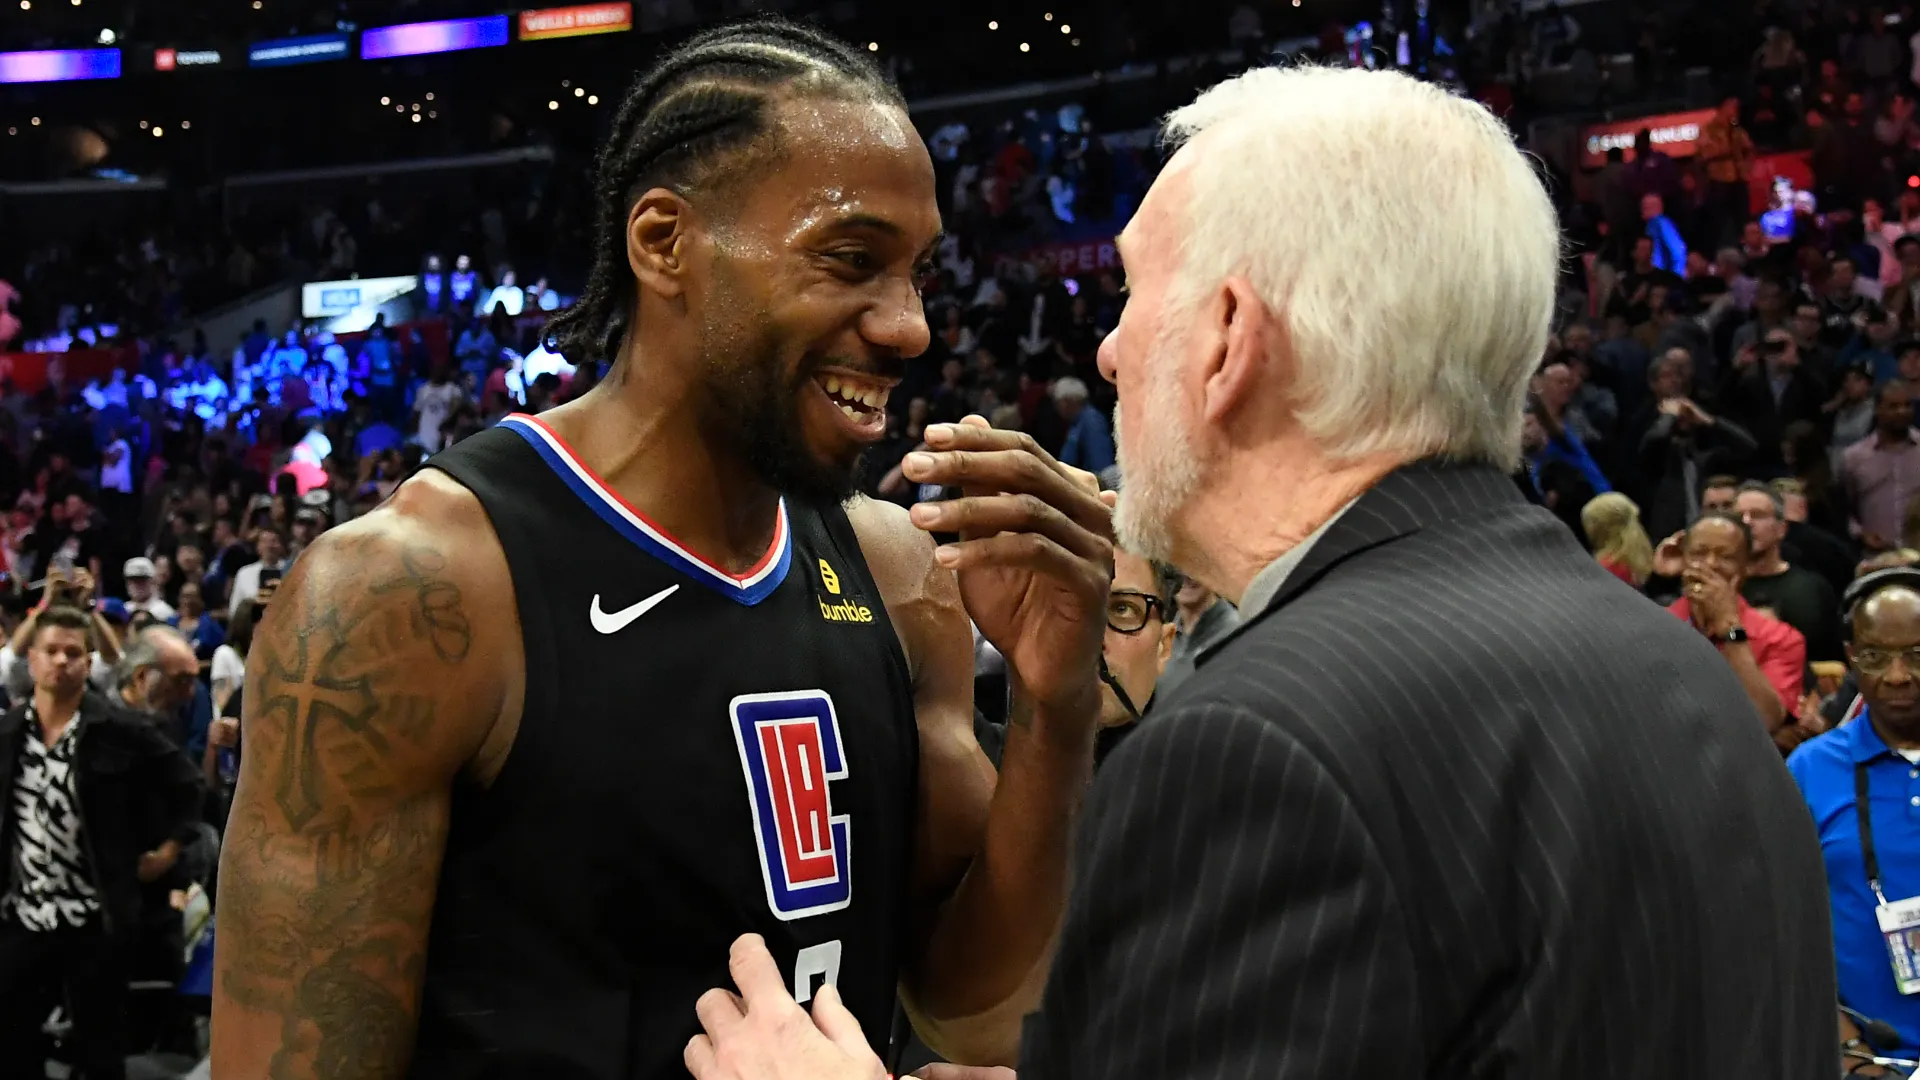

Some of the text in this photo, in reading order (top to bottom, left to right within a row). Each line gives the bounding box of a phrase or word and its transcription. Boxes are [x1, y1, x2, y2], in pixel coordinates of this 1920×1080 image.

[526, 8, 625, 31] WELLS FARGO
[1638, 123, 1700, 145] ANUEL
[817, 593, 873, 623] bumble
